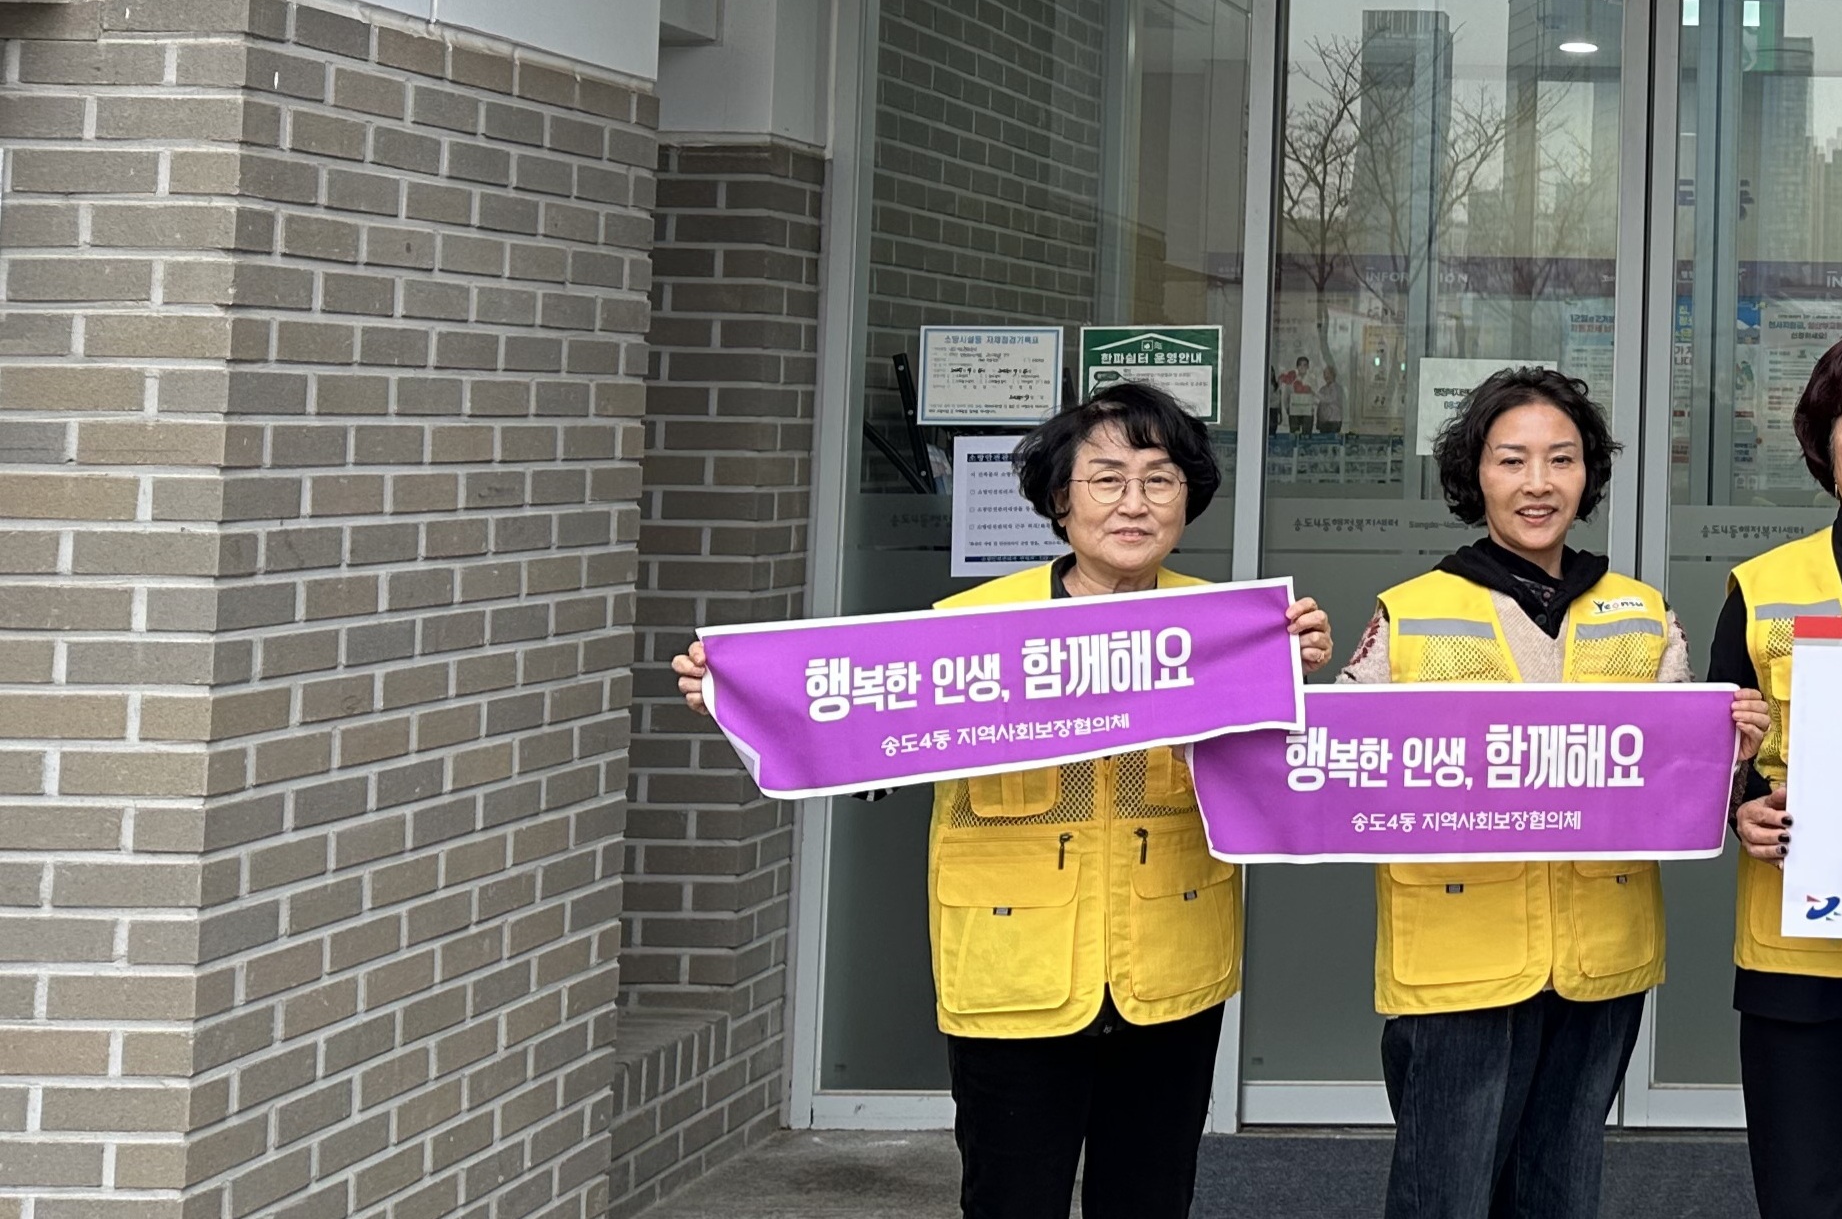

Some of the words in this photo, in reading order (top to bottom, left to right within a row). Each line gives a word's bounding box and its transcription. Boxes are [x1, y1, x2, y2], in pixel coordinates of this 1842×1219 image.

[1101, 352, 1148, 365] 한파쉼터
[1154, 352, 1202, 364] 운영안내
[805, 656, 921, 722] 행복한
[932, 652, 1010, 705] 인생,
[1021, 626, 1194, 700] 함께해요
[881, 728, 951, 757] 송도4동
[957, 712, 1130, 746] 지역사회보장협의체
[1285, 727, 1393, 792] 행복한
[1402, 737, 1473, 790] 인생,
[1486, 723, 1644, 789] 함께해요
[1351, 812, 1416, 833] 송도4동
[1422, 810, 1582, 831] 지역사회보장협의체
